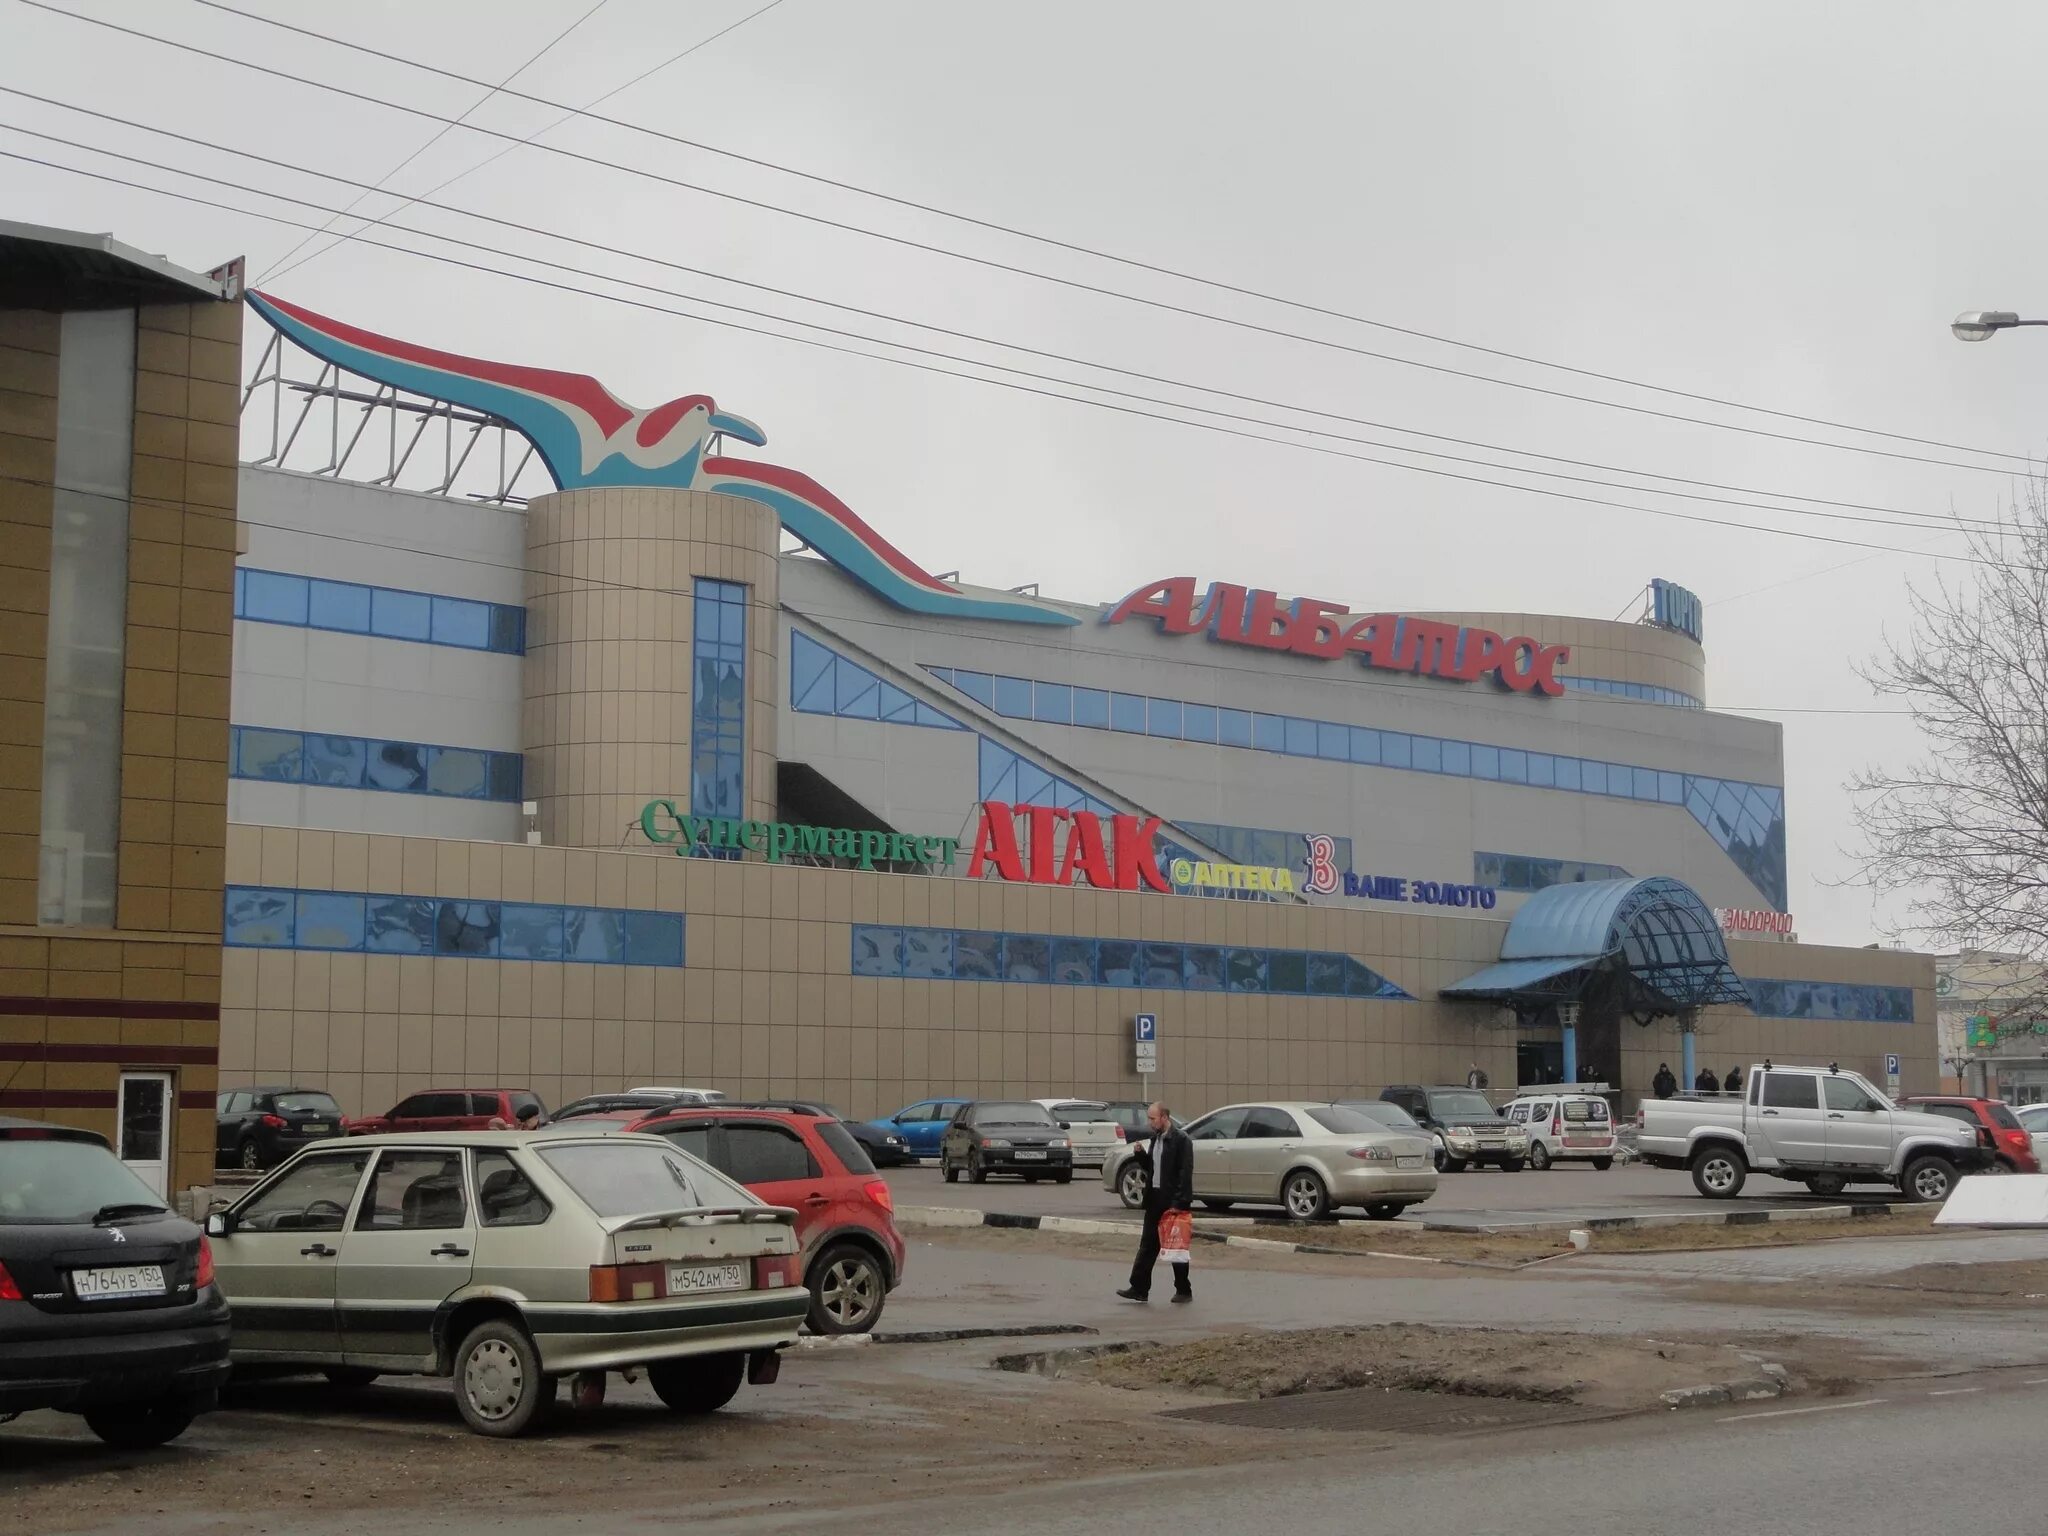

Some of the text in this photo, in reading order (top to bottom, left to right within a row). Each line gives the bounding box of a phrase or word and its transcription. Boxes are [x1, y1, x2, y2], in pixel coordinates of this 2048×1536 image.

[1102, 576, 1570, 697] АЛЬБАТРОС
[641, 799, 960, 871] Супермаркет
[967, 801, 1174, 894] АТАК
[1192, 861, 1295, 893] АПТЕКА
[1343, 871, 1497, 909] ВАШЕ ЗОЛОТО
[1140, 1017, 1151, 1038] P
